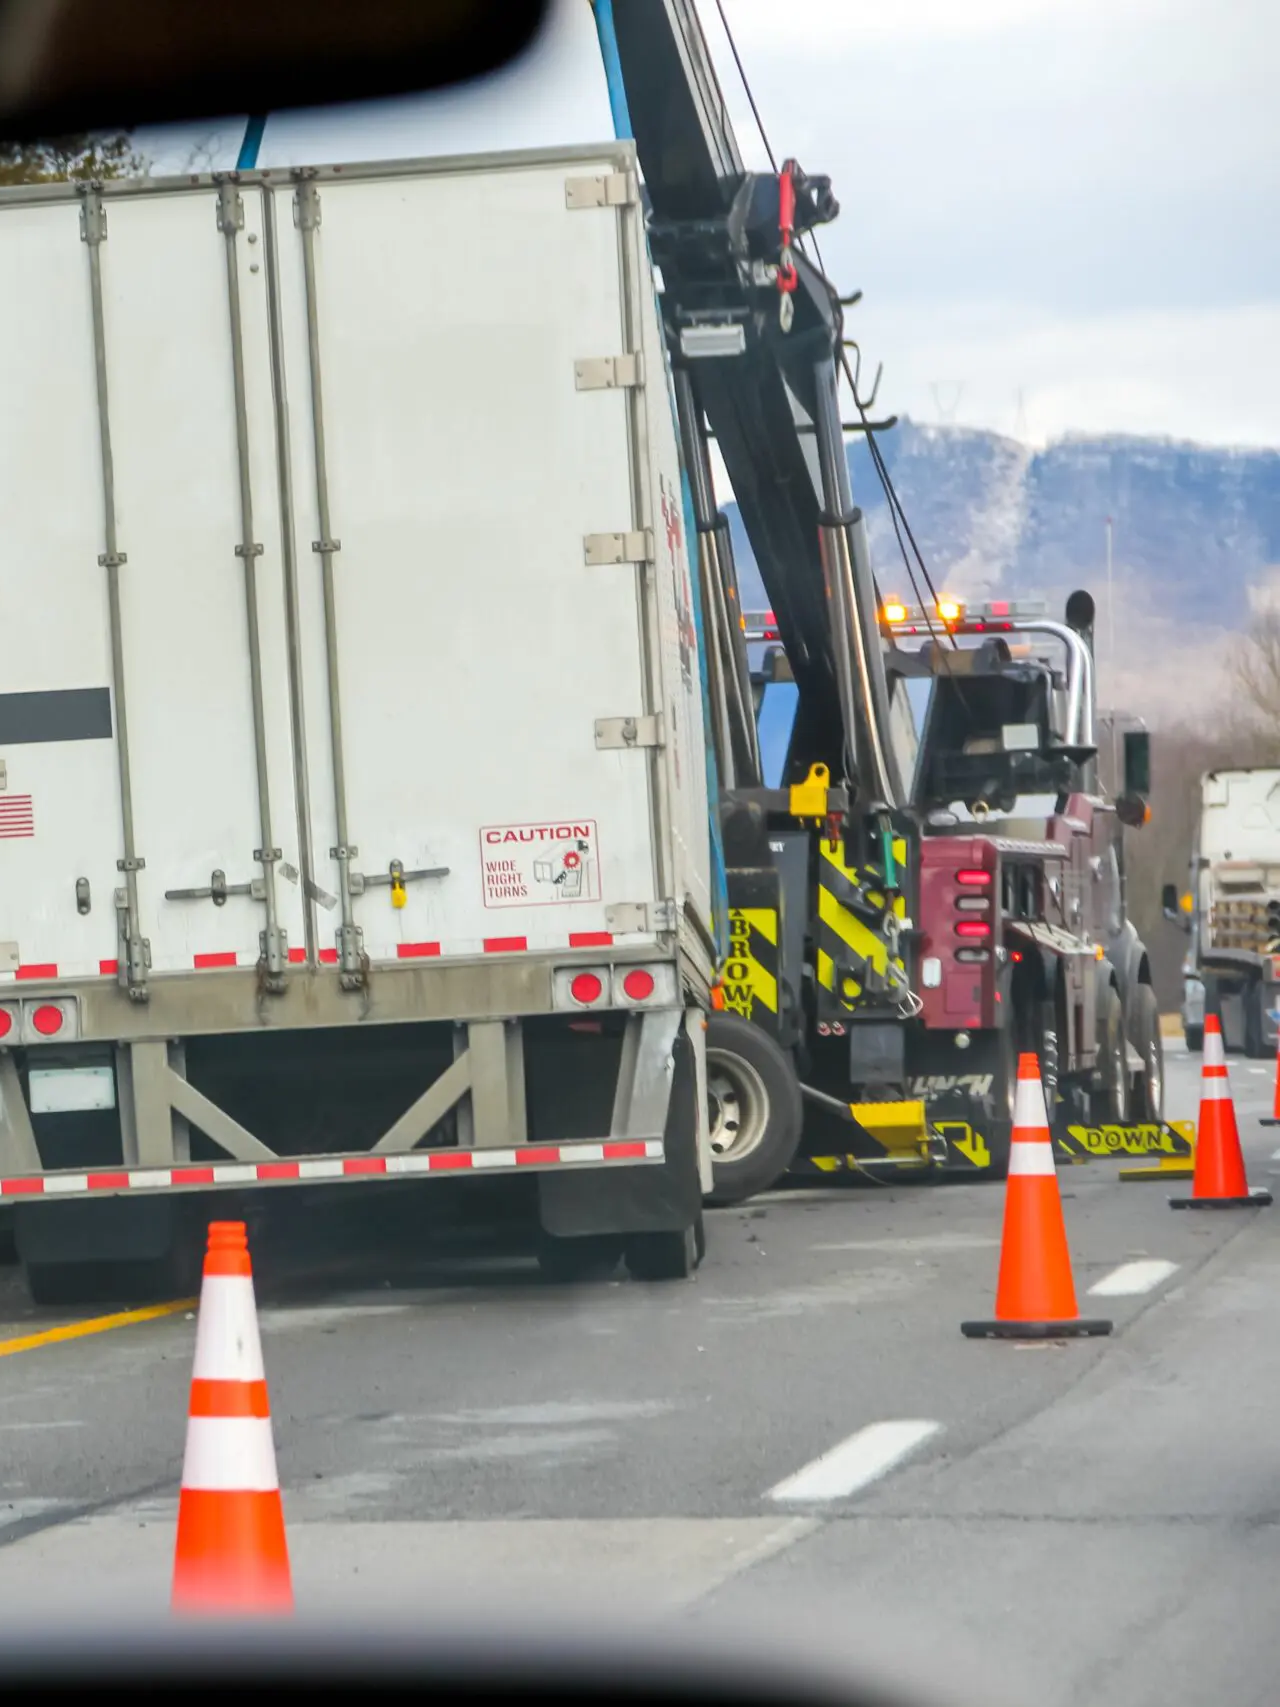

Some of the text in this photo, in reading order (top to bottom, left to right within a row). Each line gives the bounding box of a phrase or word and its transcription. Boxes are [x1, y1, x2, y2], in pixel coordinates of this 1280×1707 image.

[486, 826, 589, 844] CAUTION
[486, 860, 517, 873] WIDE
[486, 873, 523, 886] RIGHT
[488, 885, 528, 899] TURNS
[1086, 1130, 1162, 1149] DOWN
